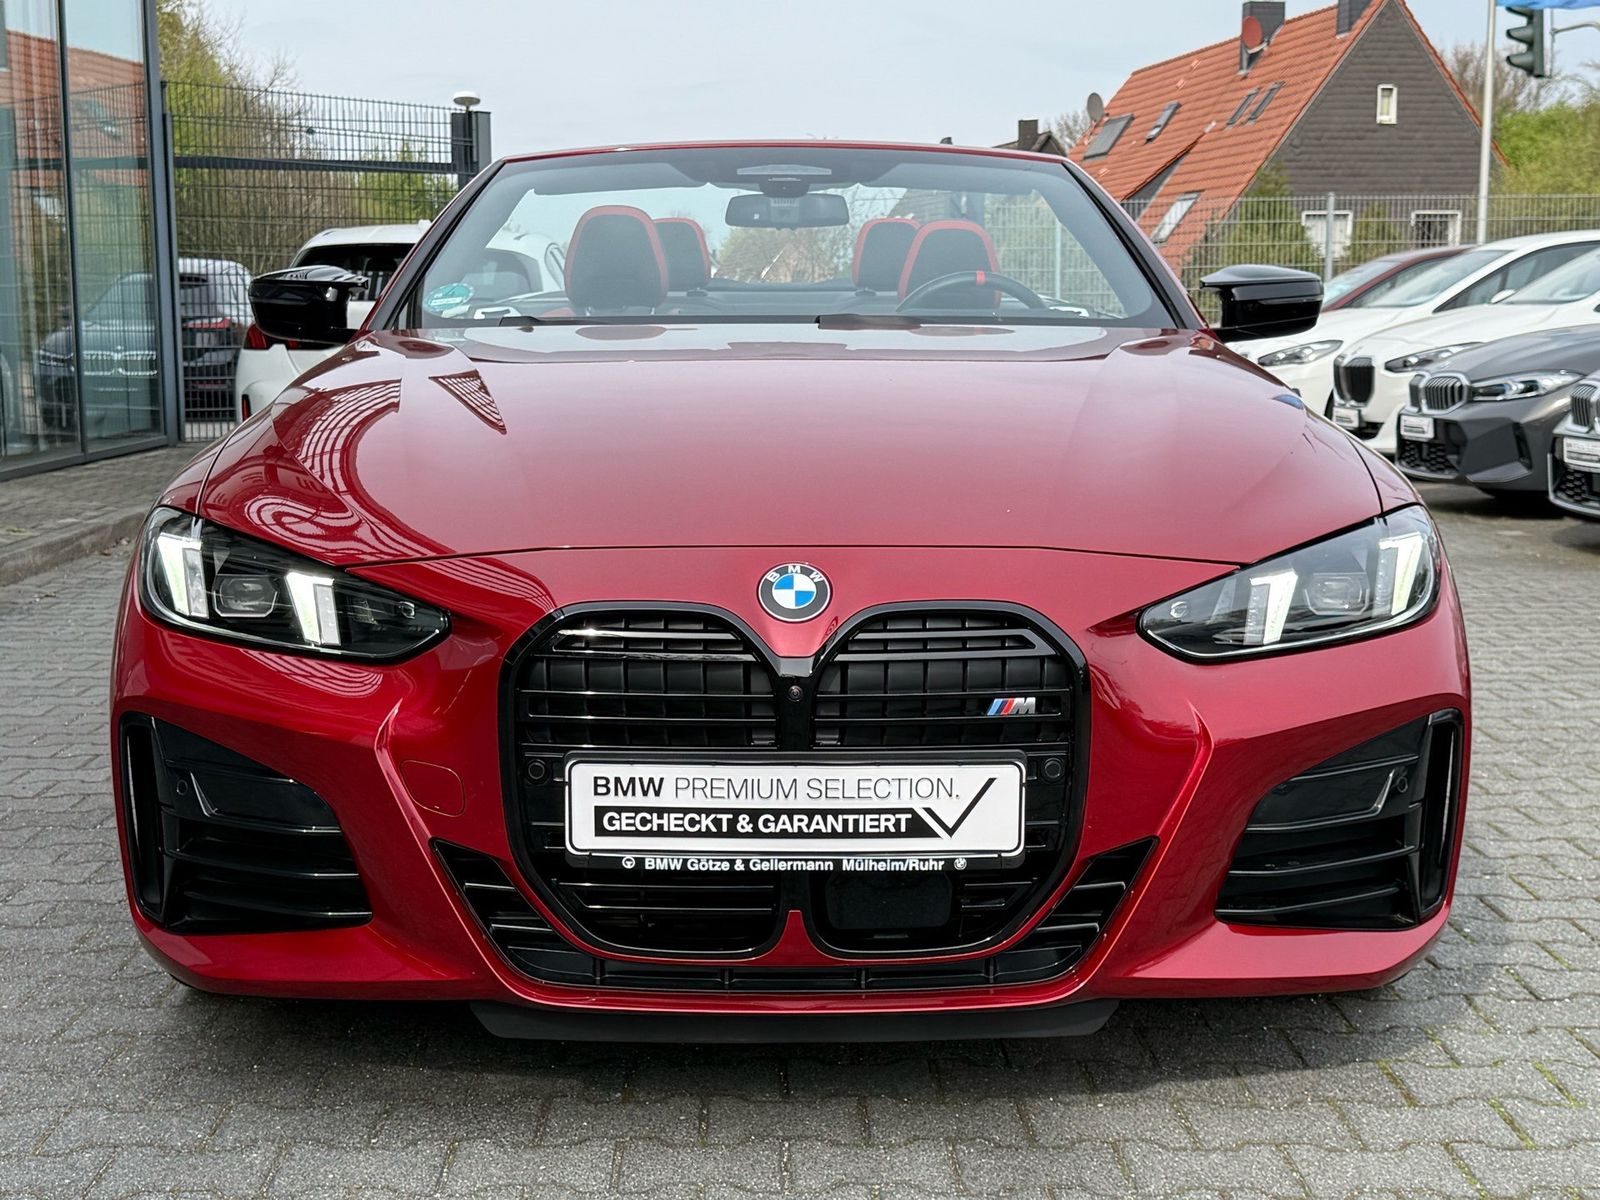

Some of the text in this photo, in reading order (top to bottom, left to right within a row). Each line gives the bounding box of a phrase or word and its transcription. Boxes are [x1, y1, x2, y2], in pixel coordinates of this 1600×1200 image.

[765, 565, 824, 583] BMW
[593, 776, 960, 800] BMW PREMIUM SELECTION.
[602, 811, 913, 833] GECHECKT & GARANTIERT
[644, 858, 945, 872] BMW Götze & Gellermann Mülheim/Ruhr
